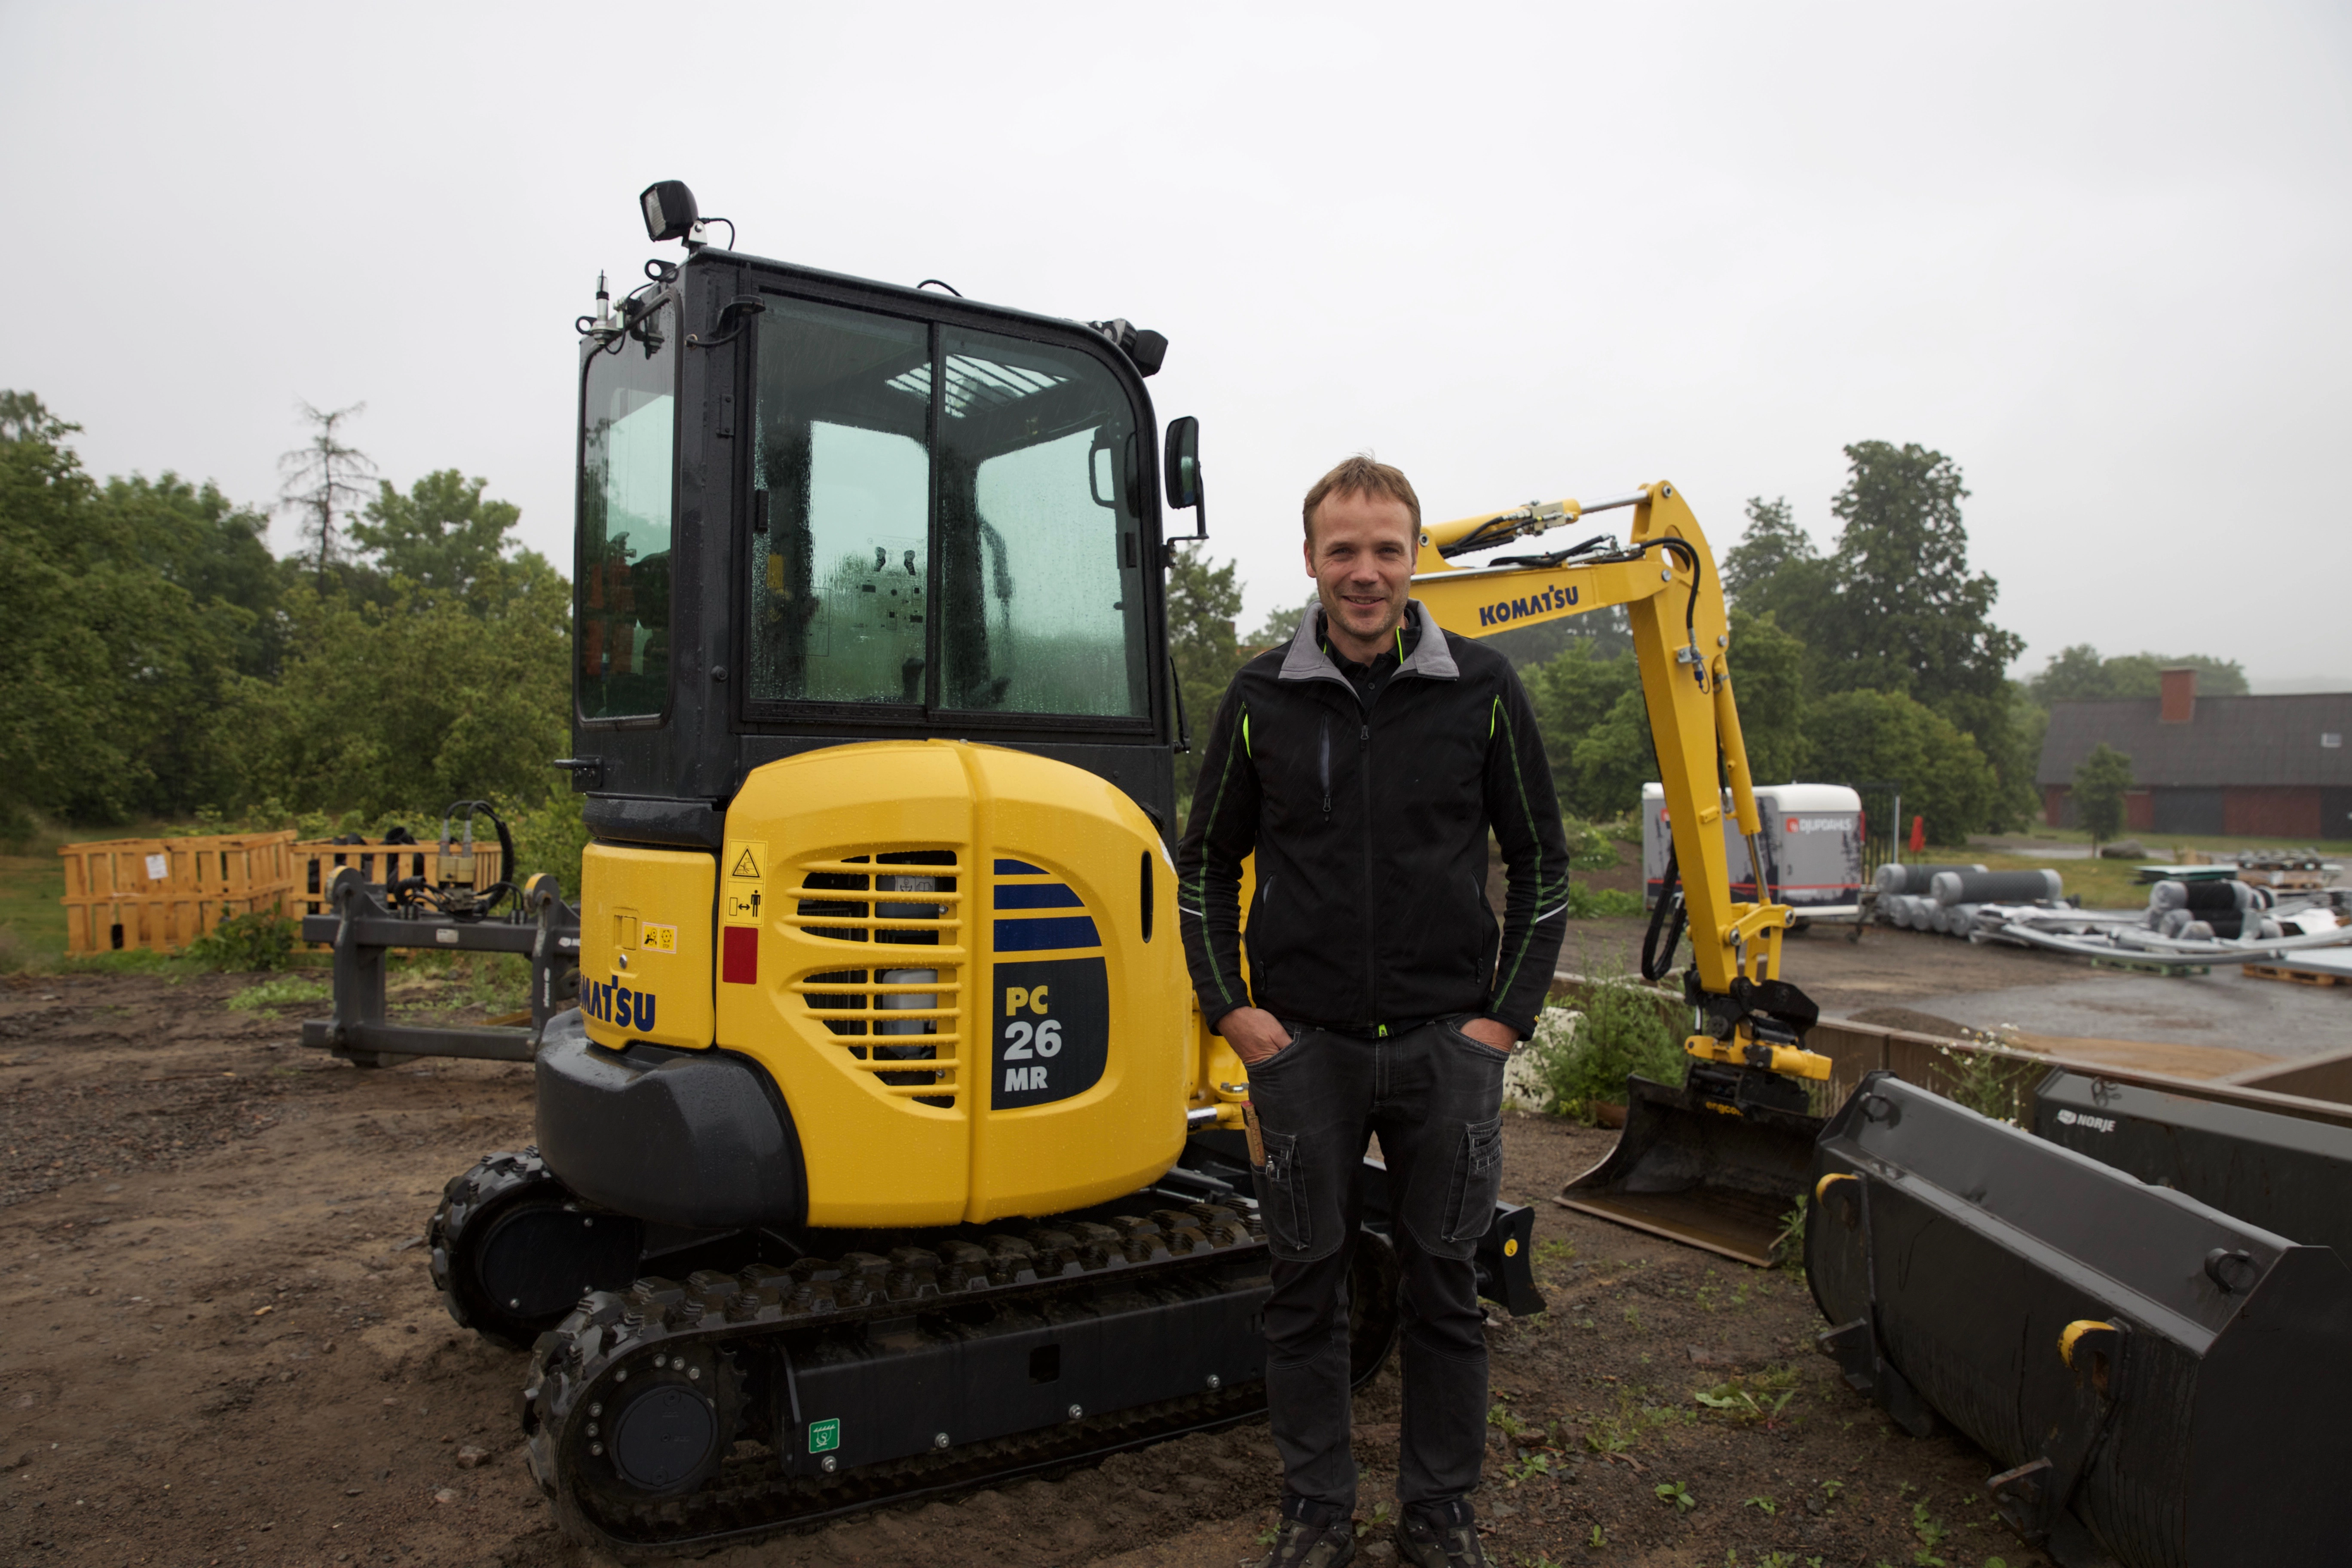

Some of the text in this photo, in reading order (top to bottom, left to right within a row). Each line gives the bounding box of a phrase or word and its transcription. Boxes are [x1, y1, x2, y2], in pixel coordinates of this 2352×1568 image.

[1479, 585, 1579, 627] KOMATSU
[579, 974, 655, 1032] MATSU
[1006, 985, 1048, 1016] PC
[1003, 1019, 1062, 1060] 26
[1004, 1066, 1048, 1092] MR
[2076, 1114, 2116, 1133] NORJE
